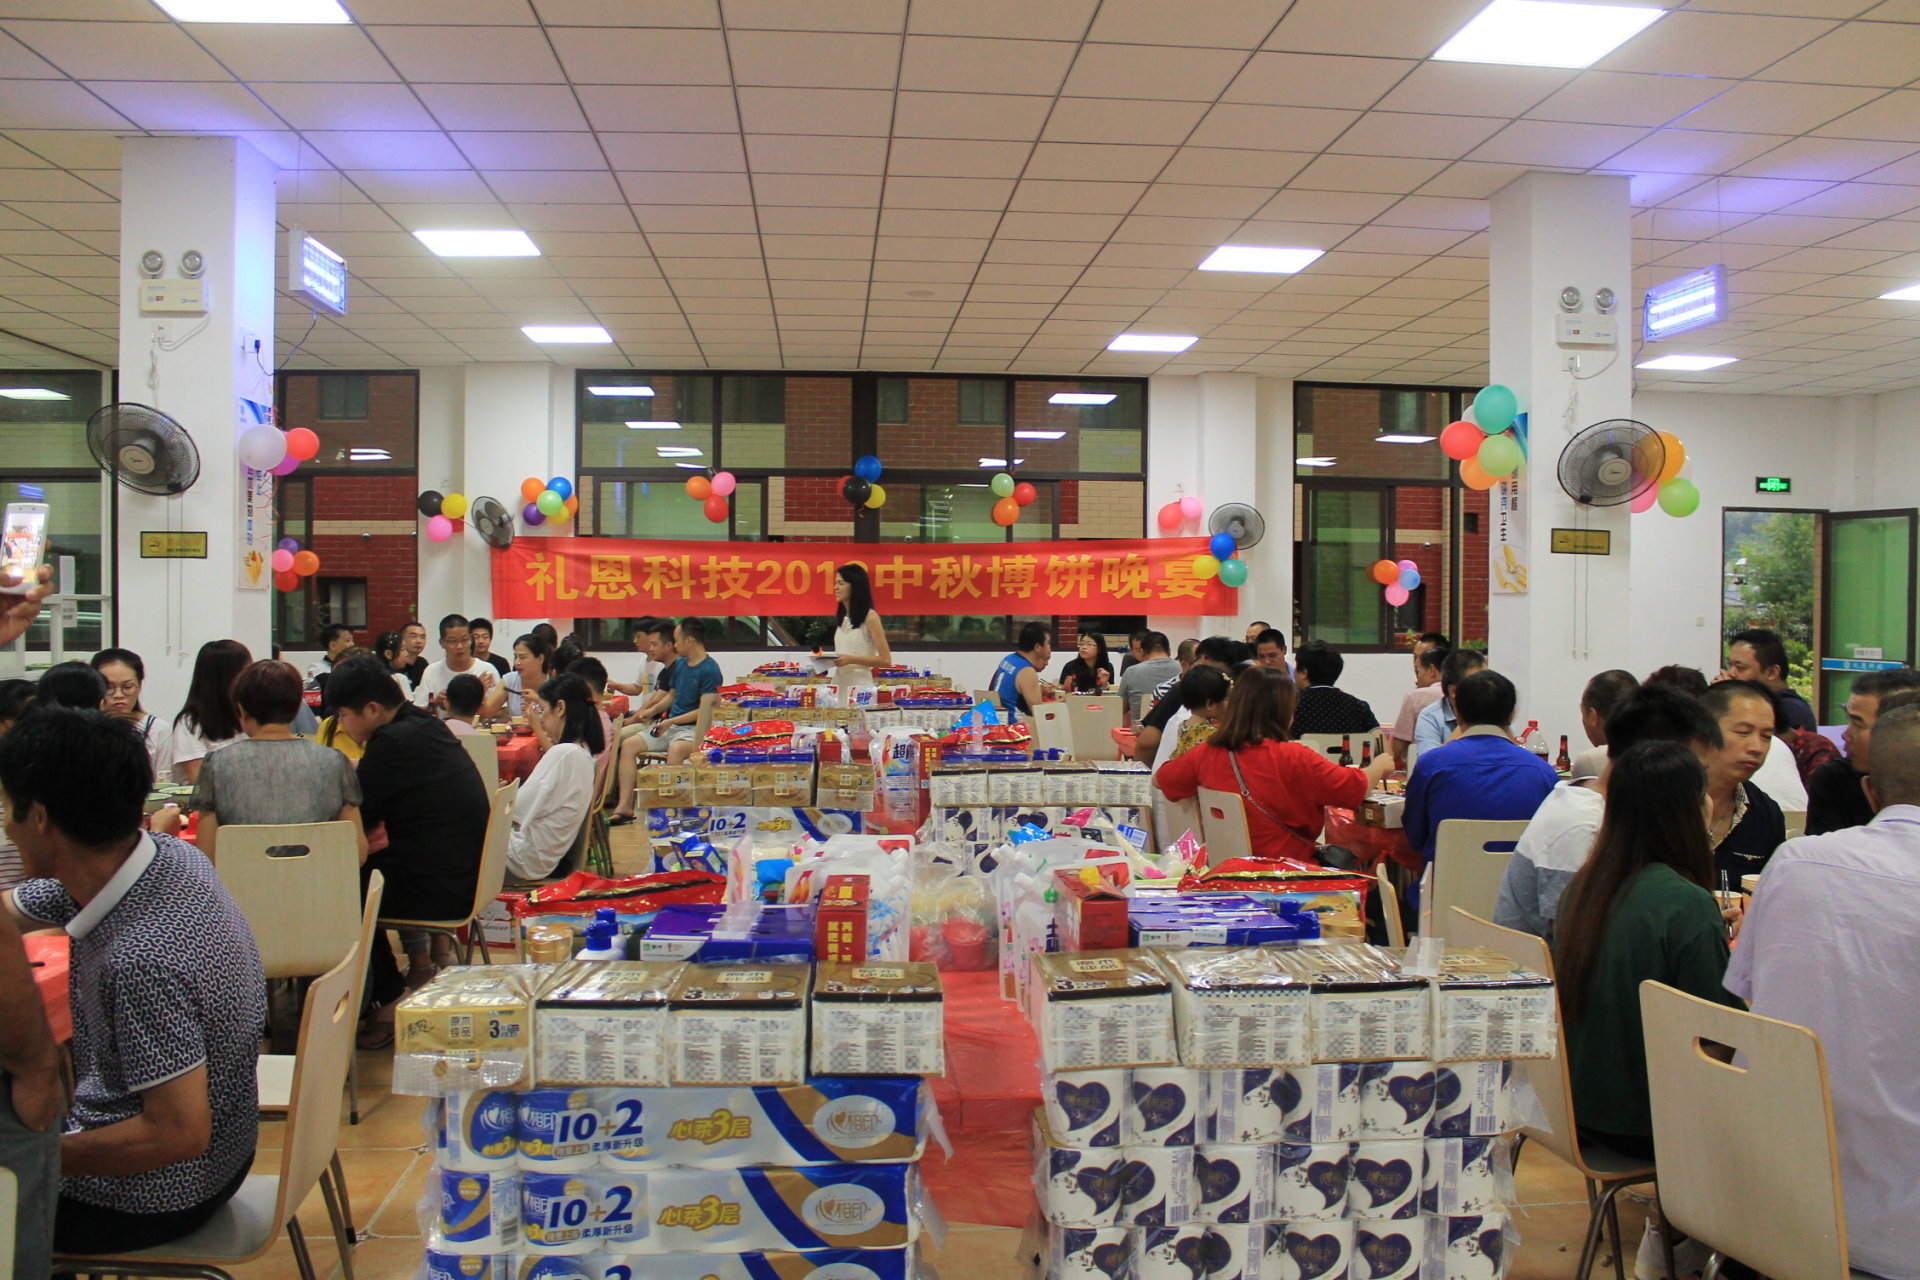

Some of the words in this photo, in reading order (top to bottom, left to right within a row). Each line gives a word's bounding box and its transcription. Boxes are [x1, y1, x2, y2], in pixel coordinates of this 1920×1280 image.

[526, 552, 1208, 600] 礼恩科技201中秋博饼晚宴
[710, 812, 746, 832] 10+2
[489, 1019, 500, 1038] 3
[558, 1098, 644, 1143] 10+2
[549, 1185, 633, 1229] 10+2
